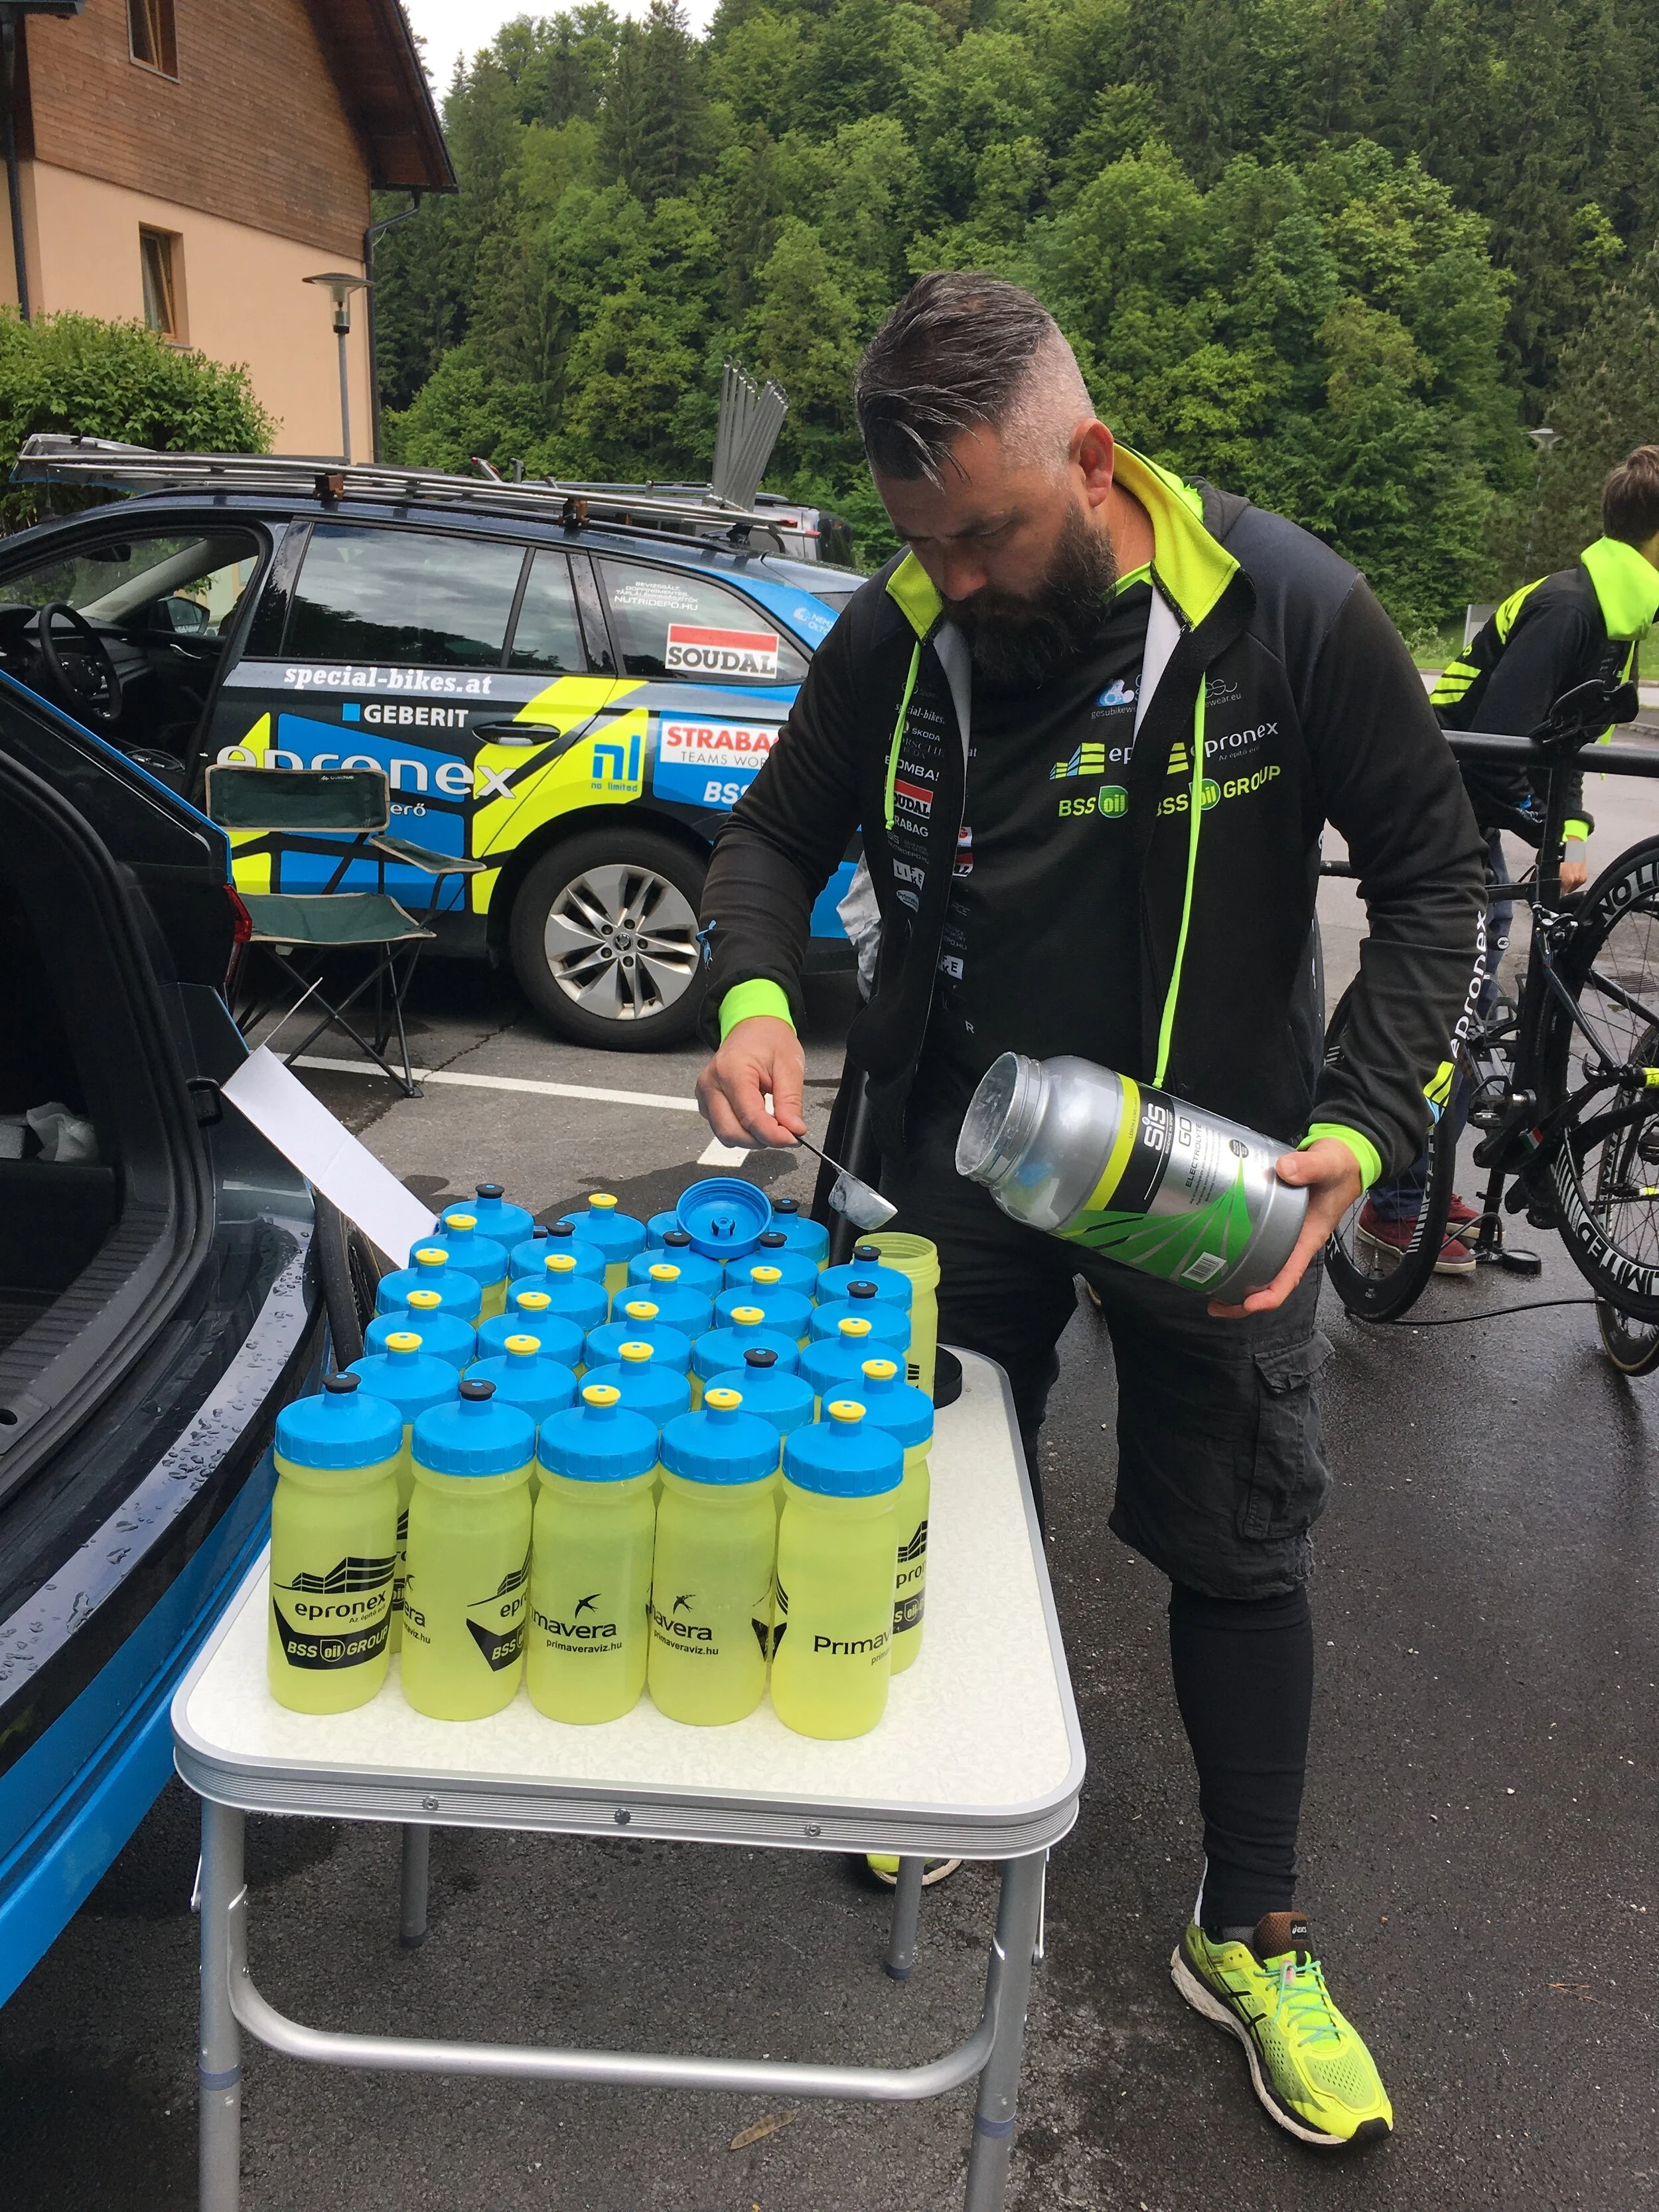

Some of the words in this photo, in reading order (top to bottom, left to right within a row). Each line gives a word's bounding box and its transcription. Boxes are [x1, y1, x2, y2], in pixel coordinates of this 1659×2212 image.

[614, 595, 699, 611] NUTRIDEPO.HU
[668, 646, 775, 674] SOUDAL
[284, 666, 492, 695] special-bikes.at
[364, 703, 469, 728] GEBERIT
[667, 727, 780, 753] STRABA
[682, 751, 727, 766] TEAMS
[608, 782, 638, 792] limited
[1157, 794, 1189, 817] SS
[1223, 766, 1281, 798] GROUP
[1058, 796, 1096, 817] BSS
[1104, 795, 1125, 813] oil
[1451, 910, 1486, 1059] epronex
[1179, 1116, 1192, 1147] GO
[1185, 1122, 1202, 1188] ELECTROLYTE
[295, 1589, 386, 1621] epronex
[906, 1603, 918, 1619] oil
[287, 1641, 318, 1658] BSS
[324, 1645, 341, 1659] oil
[346, 1625, 388, 1656] GROUP
[491, 1638, 516, 1660] BSS
[546, 1639, 622, 1653] primaveraviz.hu
[654, 1629, 719, 1655] primaveraviz.hu
